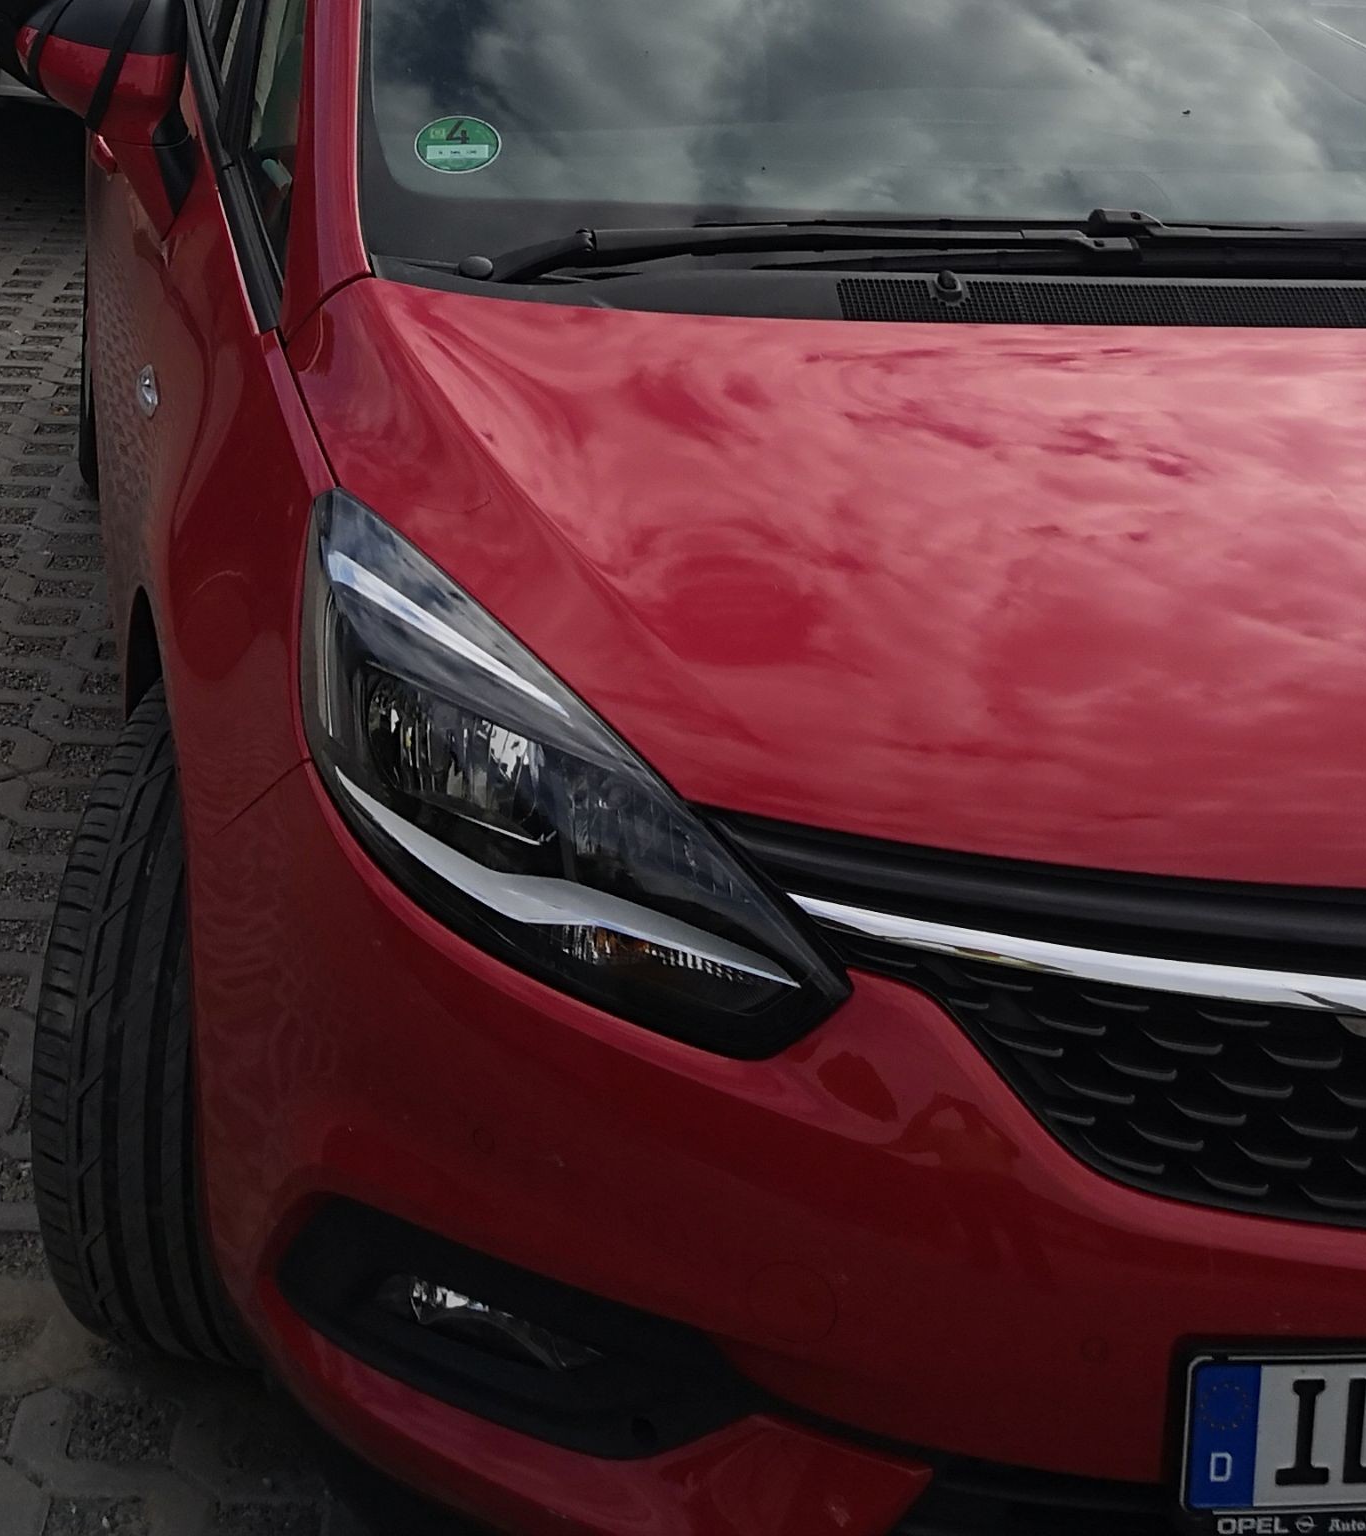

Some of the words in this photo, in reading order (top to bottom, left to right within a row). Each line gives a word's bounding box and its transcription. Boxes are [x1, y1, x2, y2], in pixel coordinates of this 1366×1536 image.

[445, 119, 471, 145] 4
[1210, 1451, 1233, 1482] D
[1216, 1516, 1290, 1535] OPEL
